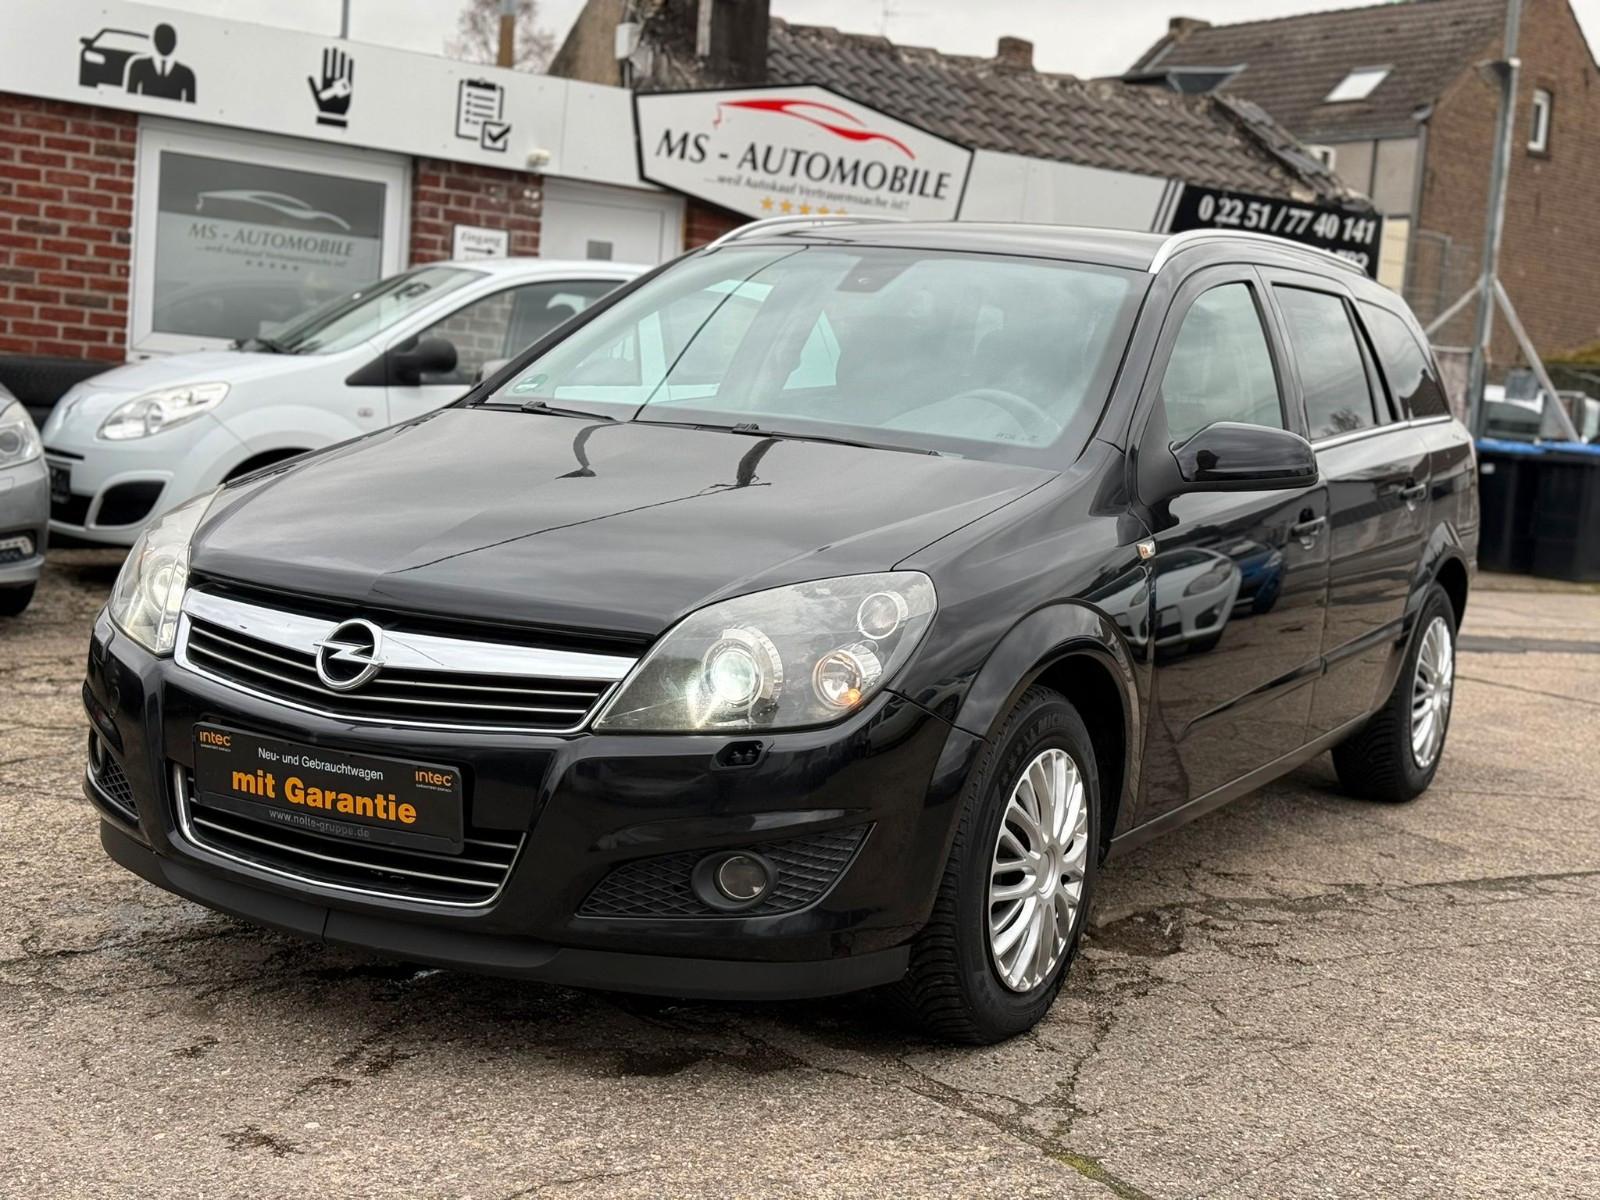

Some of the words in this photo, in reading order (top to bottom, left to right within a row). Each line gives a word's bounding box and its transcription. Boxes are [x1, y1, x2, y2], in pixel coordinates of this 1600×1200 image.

[655, 128, 710, 164] MS
[737, 141, 951, 200] AUTOMOBILE
[1198, 194, 1215, 221] 0
[1214, 197, 1244, 225] 22
[1243, 202, 1272, 230] 51
[1284, 208, 1314, 235] 77
[1312, 212, 1340, 240] 40
[1343, 217, 1376, 244] 141
[188, 222, 218, 240] MS
[233, 228, 355, 257] AUTOMOBILE
[199, 731, 231, 747] intec
[258, 747, 280, 762] Neu-
[282, 752, 299, 766] und
[301, 756, 383, 782] Gebrauchtwagen
[415, 770, 452, 787] intec
[232, 769, 275, 799] mit
[284, 776, 417, 824] Garantie
[269, 809, 370, 838] www.nolte-gruppe.de
